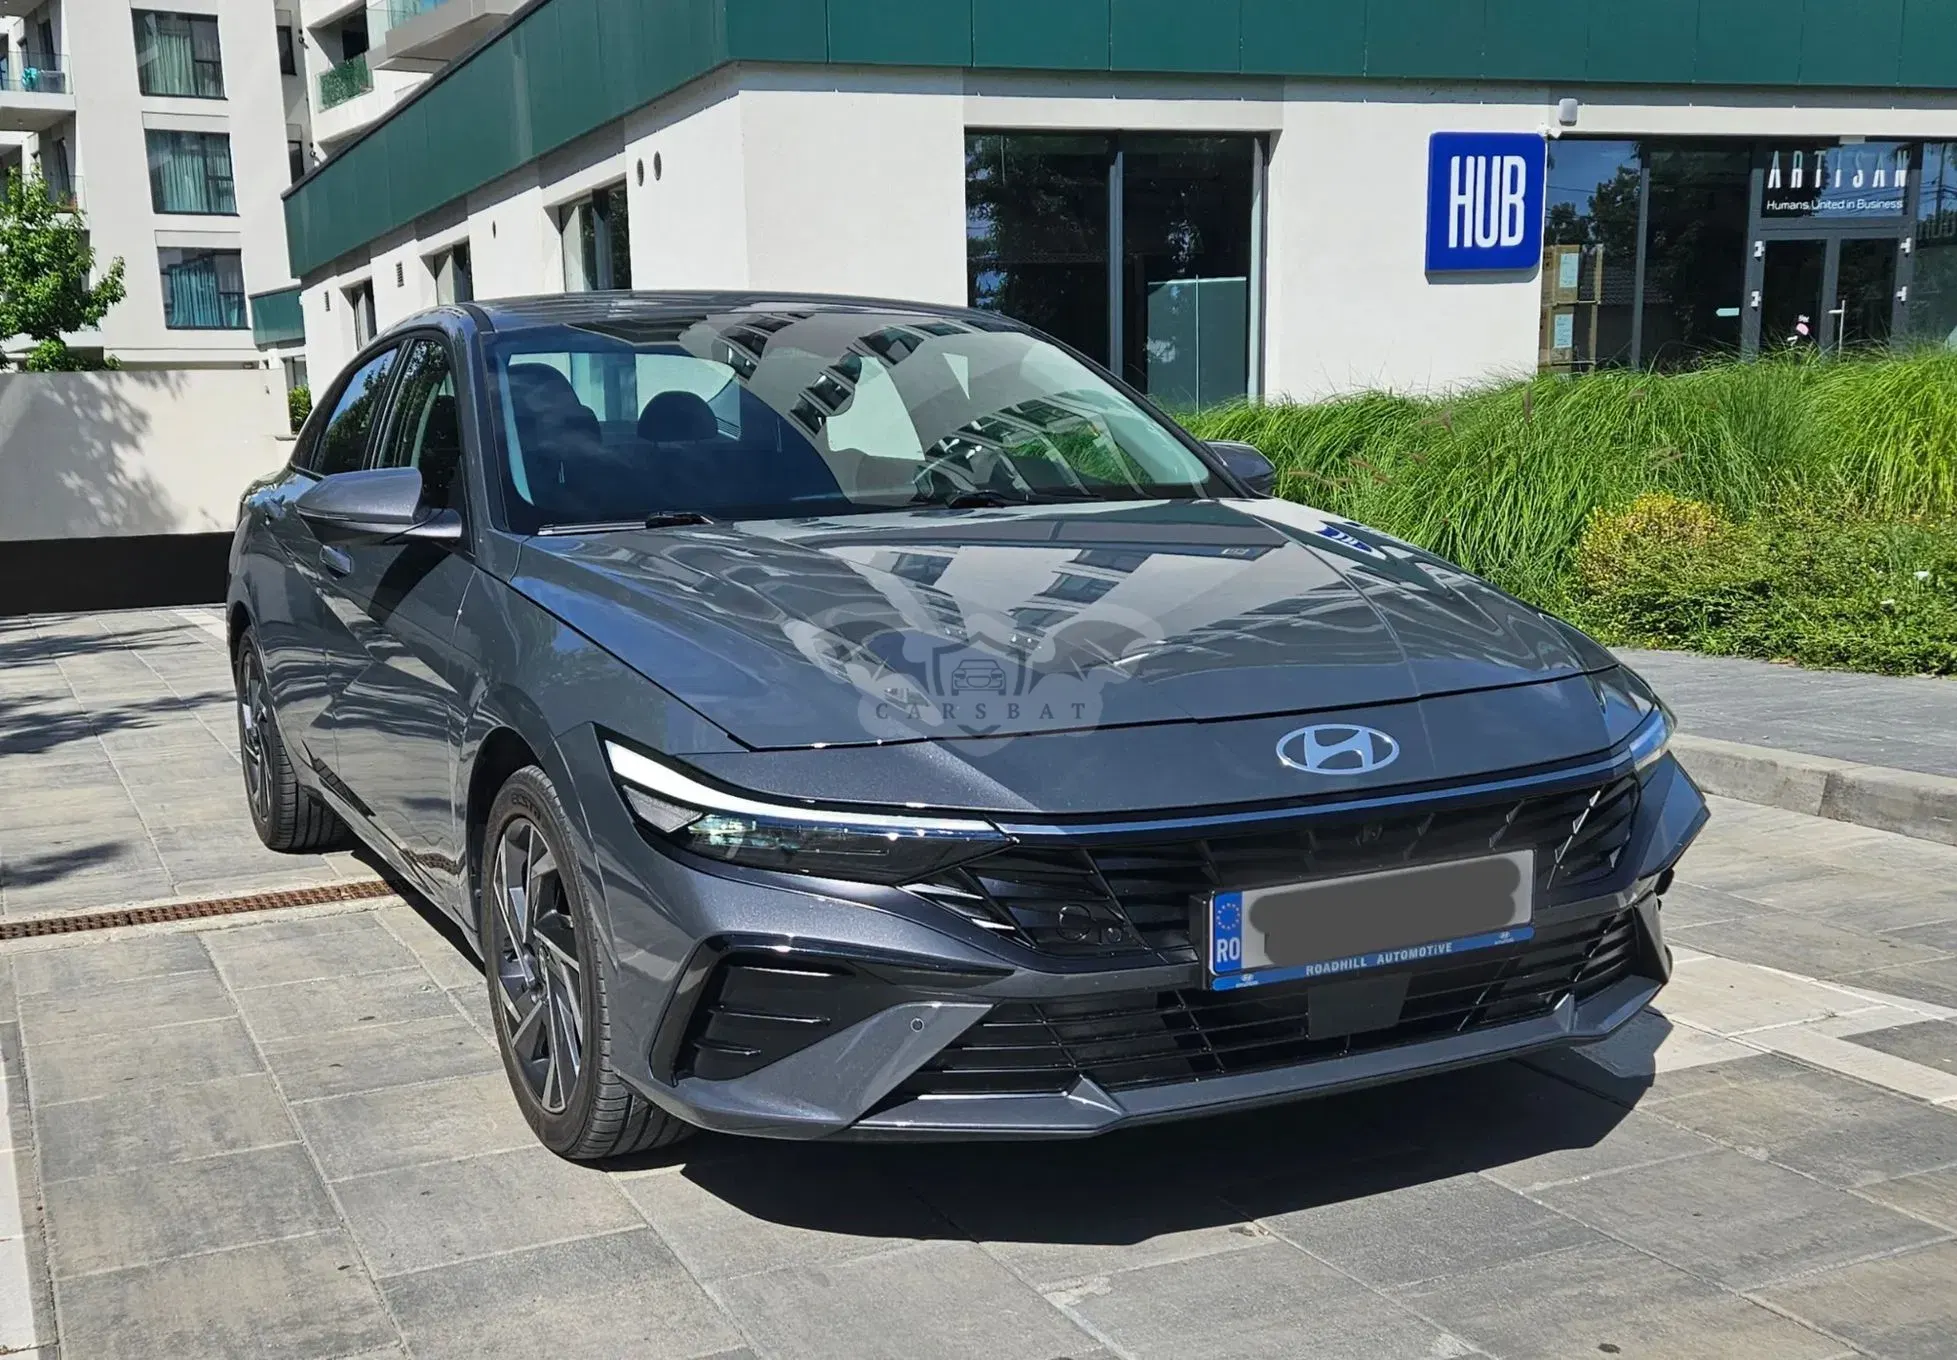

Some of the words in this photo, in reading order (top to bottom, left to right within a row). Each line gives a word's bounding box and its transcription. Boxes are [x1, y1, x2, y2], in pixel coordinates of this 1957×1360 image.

[1768, 150, 1908, 188] ARTISAN
[1449, 156, 1526, 248] HUB
[1811, 199, 1845, 210] United
[1846, 199, 1855, 209] in
[1857, 198, 1904, 209] Business
[1217, 938, 1241, 963] RO
[1306, 957, 1368, 976] ROADHILL
